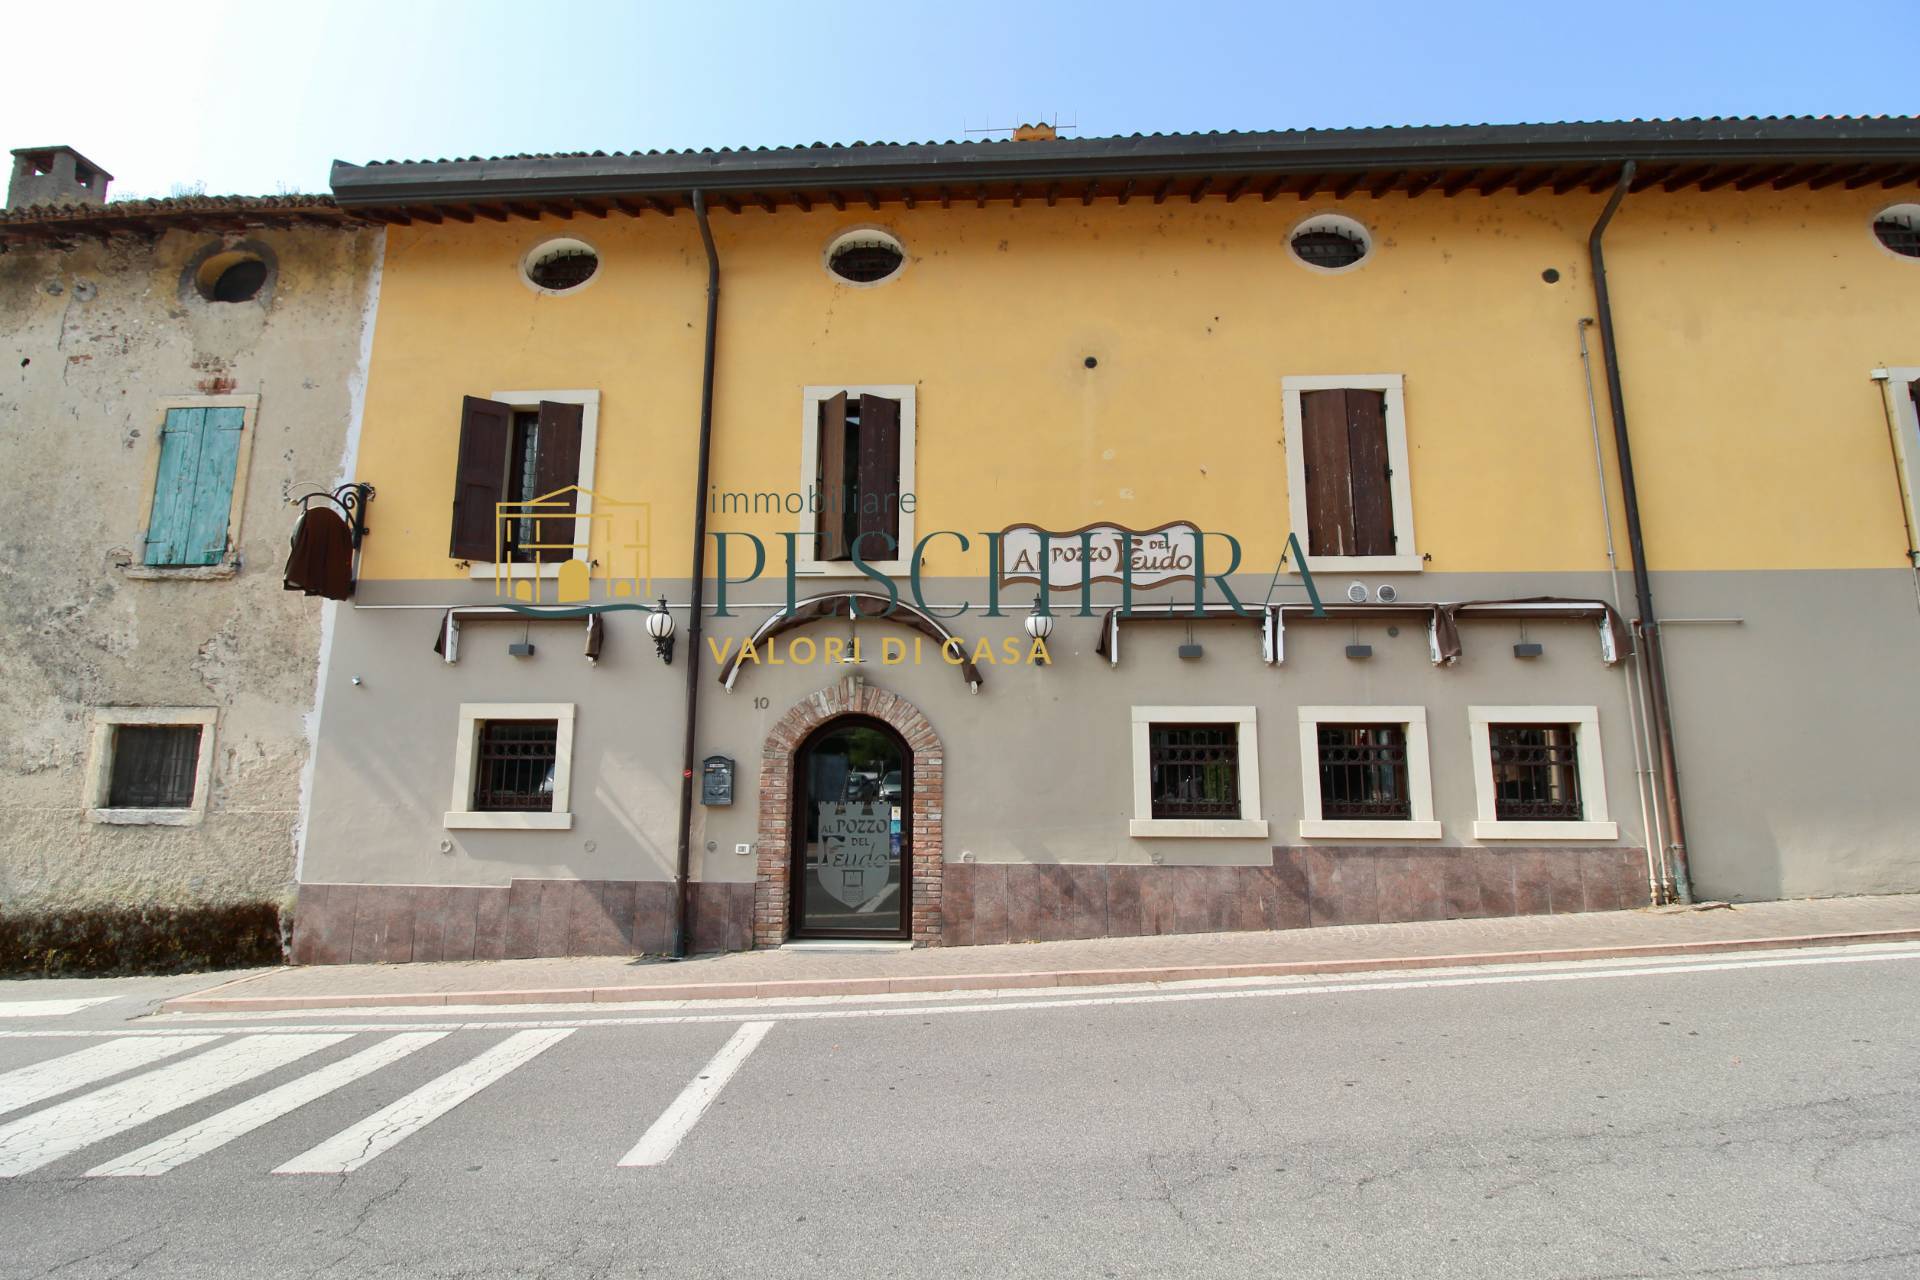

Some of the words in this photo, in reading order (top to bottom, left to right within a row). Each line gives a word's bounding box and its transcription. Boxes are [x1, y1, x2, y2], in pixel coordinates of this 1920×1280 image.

[1051, 546, 1111, 563] POZZO
[1149, 540, 1171, 550] DEL
[753, 696, 769, 710] 10
[836, 819, 888, 834] POZZO
[851, 837, 870, 846] DEL
